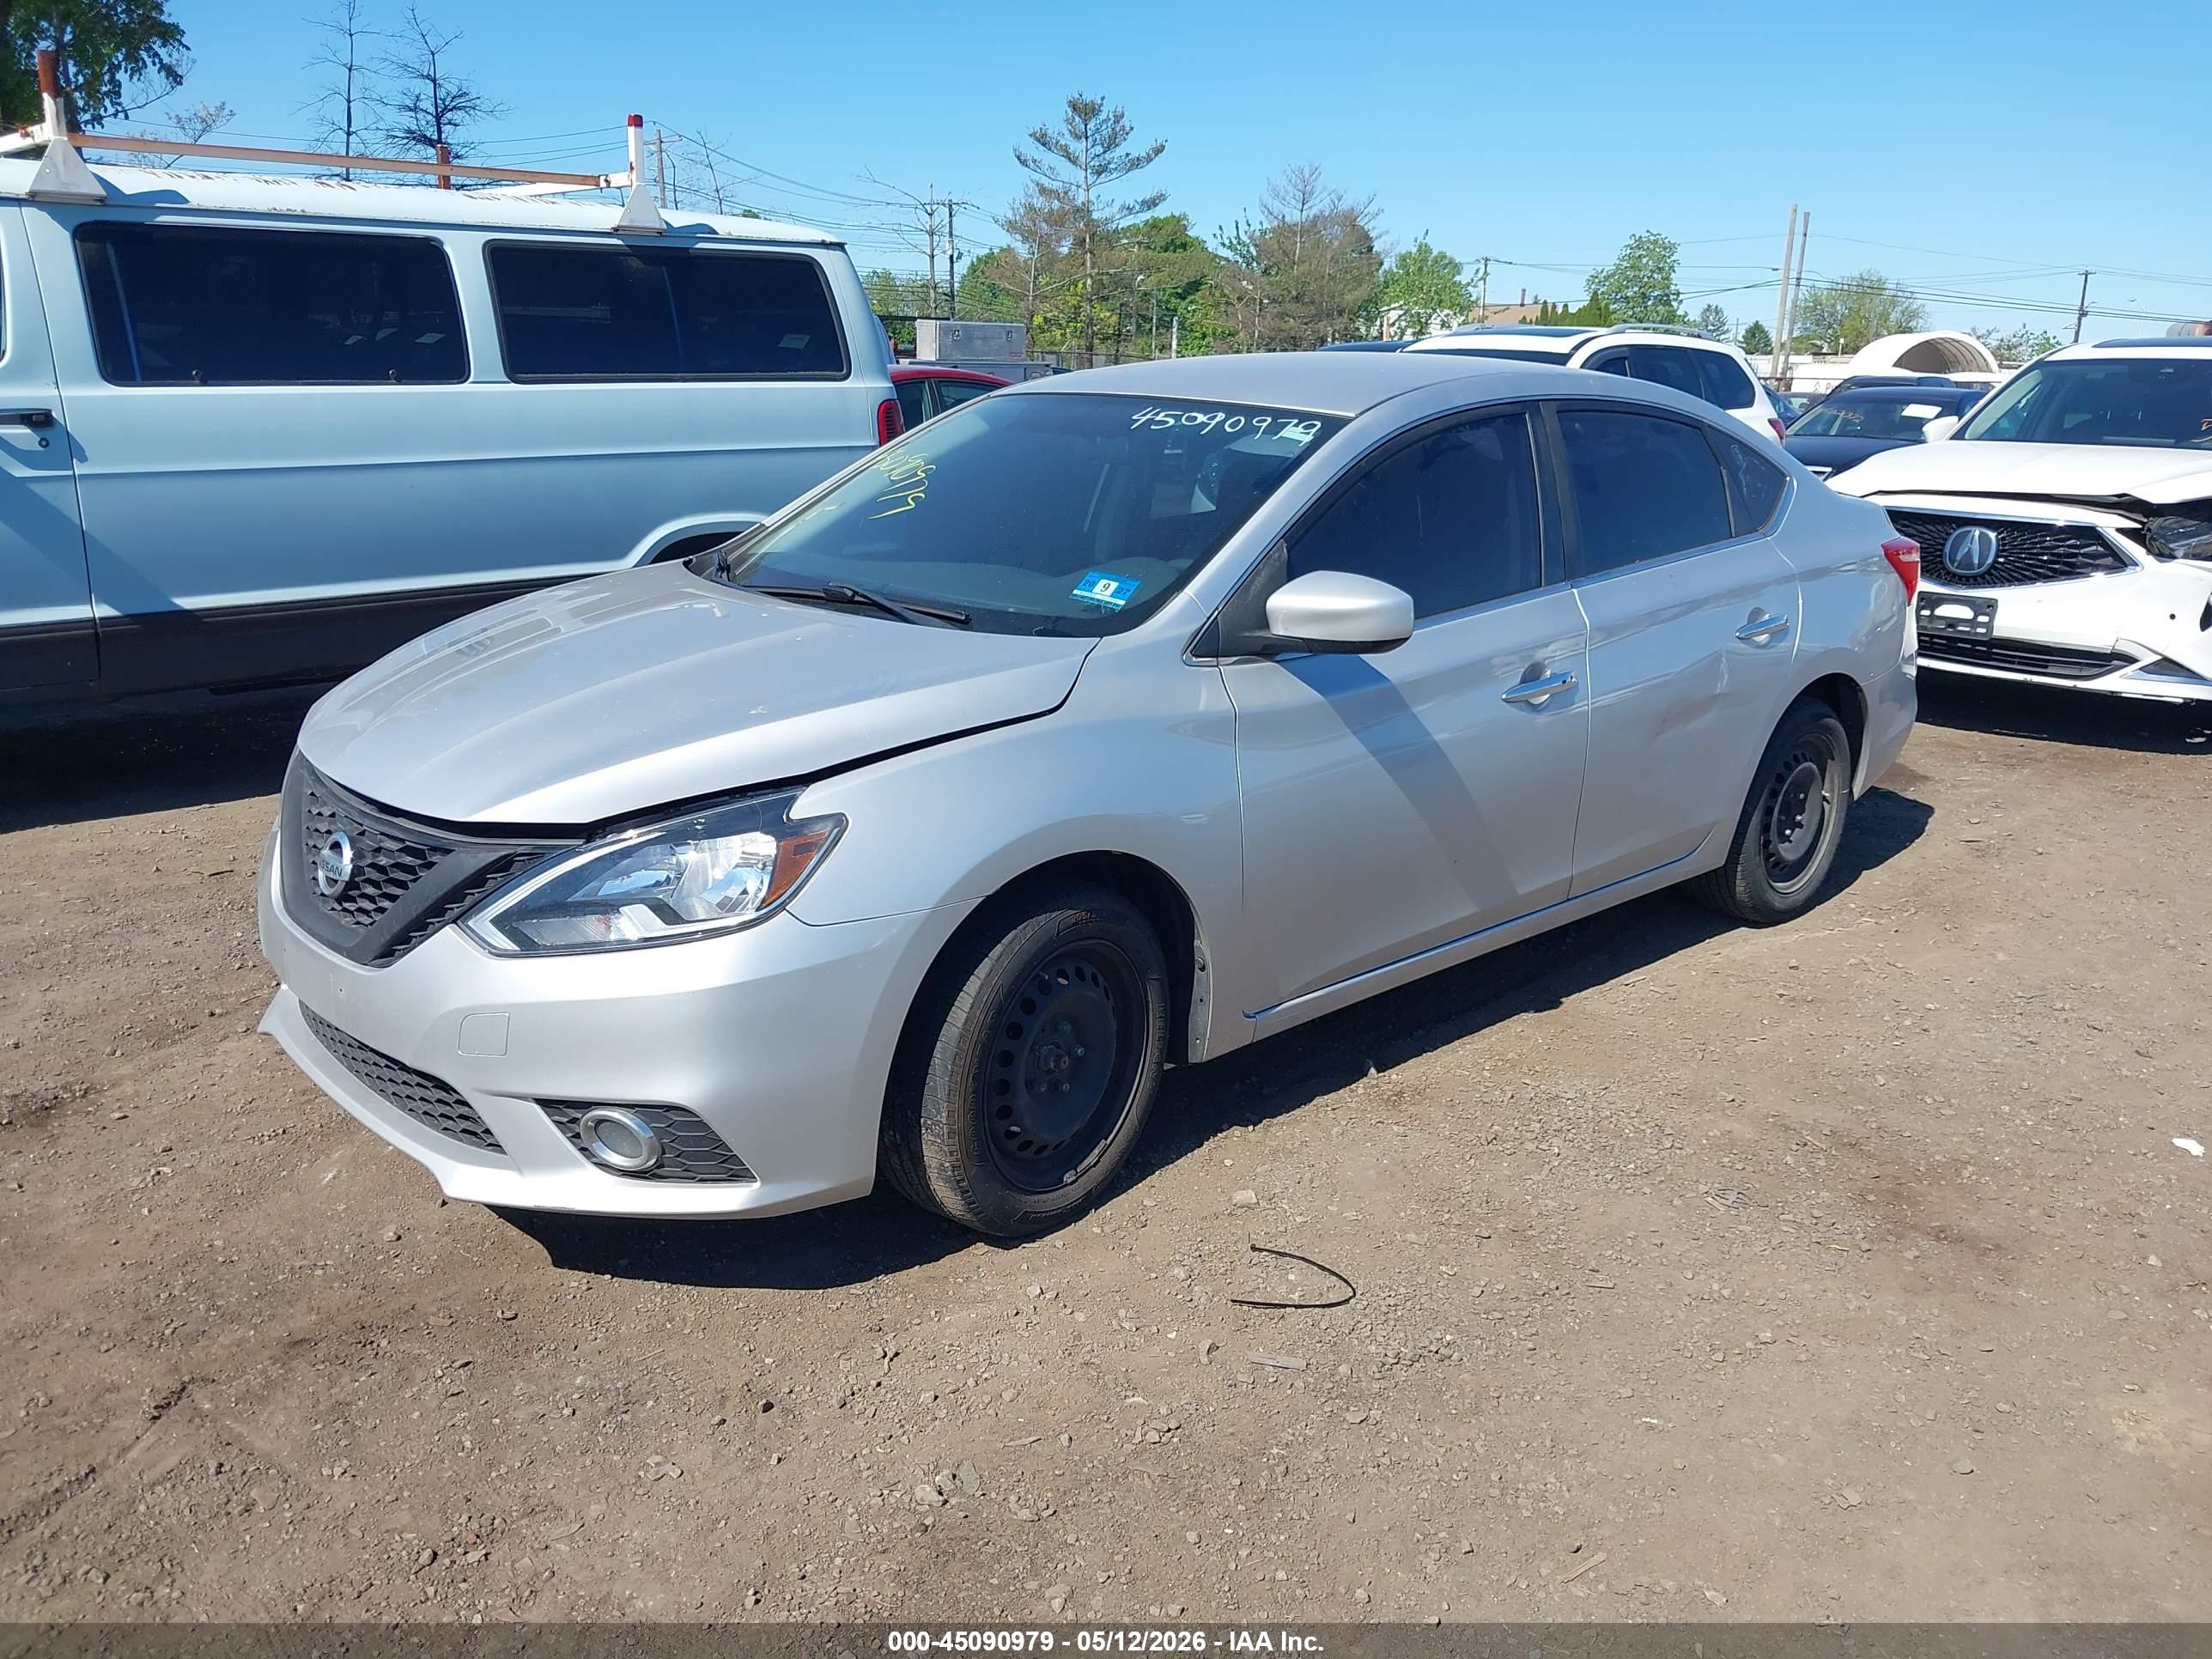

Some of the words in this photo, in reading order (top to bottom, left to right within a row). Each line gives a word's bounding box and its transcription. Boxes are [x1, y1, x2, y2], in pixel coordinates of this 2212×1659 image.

[1130, 406, 1322, 447] 45090979
[1082, 579, 1096, 588] 20
[1100, 582, 1111, 592] 9
[1116, 586, 1130, 596] 27
